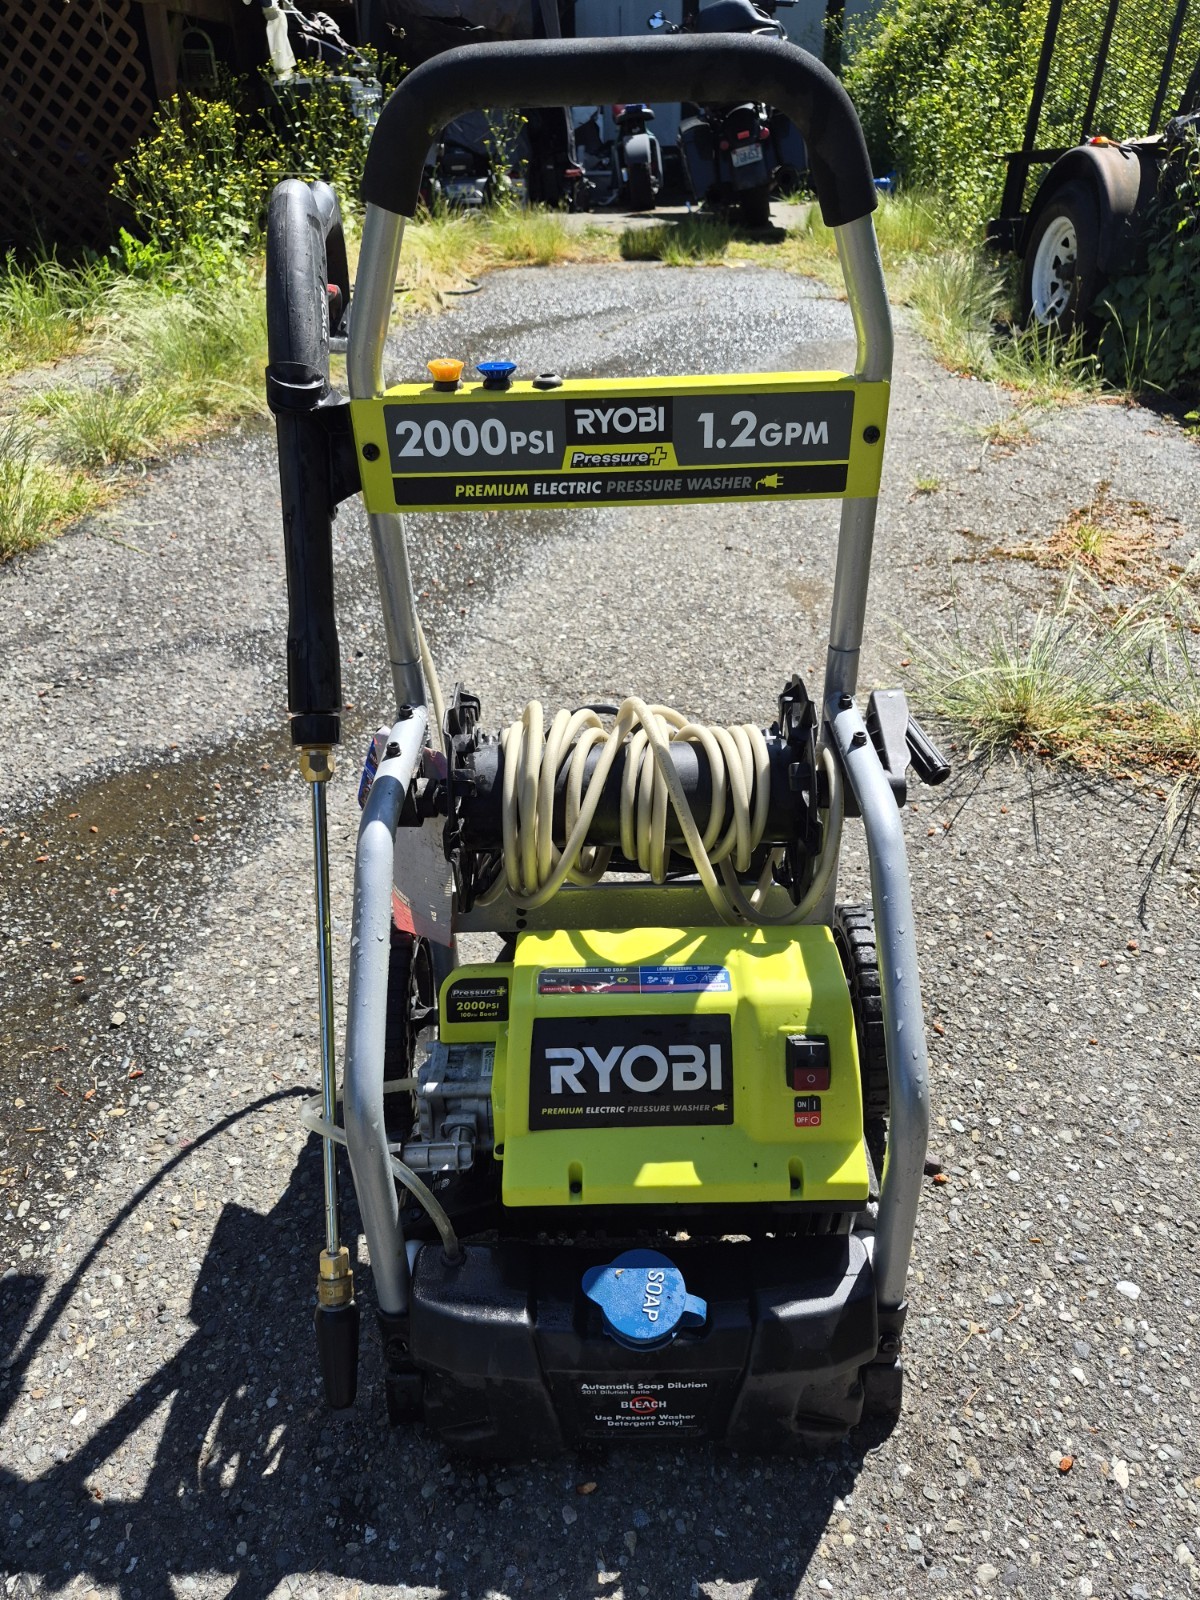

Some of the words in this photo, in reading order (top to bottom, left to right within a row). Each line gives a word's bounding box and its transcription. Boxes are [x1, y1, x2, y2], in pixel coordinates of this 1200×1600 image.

[574, 406, 666, 435] RYOBI
[697, 409, 830, 451] 1.2GPM
[395, 419, 555, 458] 2000PSI
[455, 482, 529, 498] PREMIUM
[533, 480, 603, 496] ELECTRIC
[606, 478, 683, 494] PRESSURE
[685, 475, 753, 491] WASHER
[456, 1001, 500, 1011] 2000PSI
[545, 1044, 723, 1094] RYOBI
[541, 1107, 583, 1115] PREMIUM
[585, 1106, 625, 1114] ELECTRIC
[627, 1105, 670, 1113] PRESSURE
[673, 1104, 710, 1112] WASHER
[642, 1269, 665, 1323] SOAP
[637, 1383, 664, 1391] Soap
[621, 1401, 667, 1409] BLEACH
[607, 1420, 655, 1428] Detergent
[657, 1419, 683, 1427] Only!
